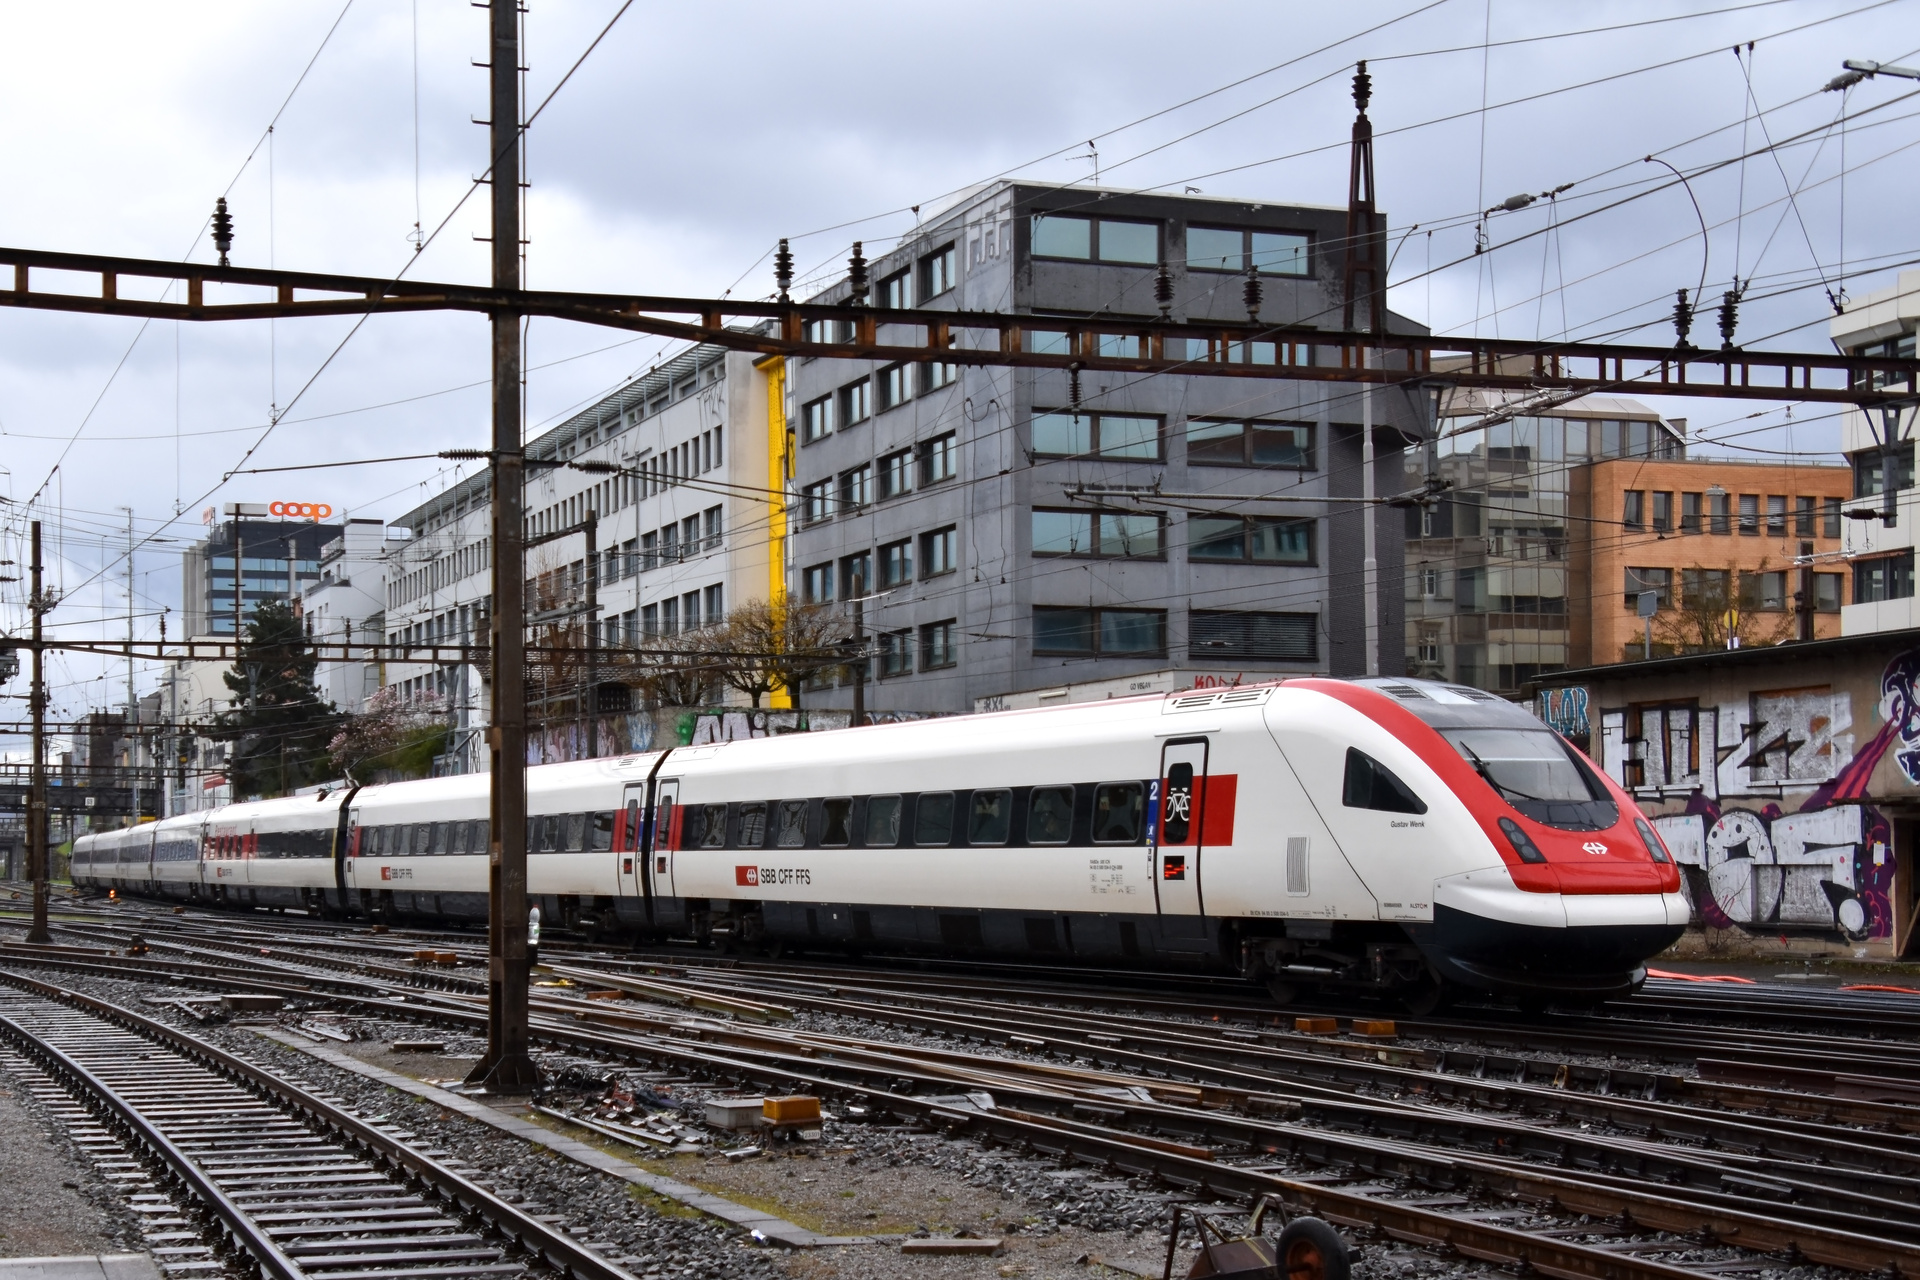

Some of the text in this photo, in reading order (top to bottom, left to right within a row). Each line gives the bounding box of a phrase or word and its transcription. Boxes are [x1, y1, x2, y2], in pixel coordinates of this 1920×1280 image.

[269, 501, 332, 523] coop
[1150, 782, 1158, 800] 2
[761, 868, 811, 885] SBB CFF FFS
